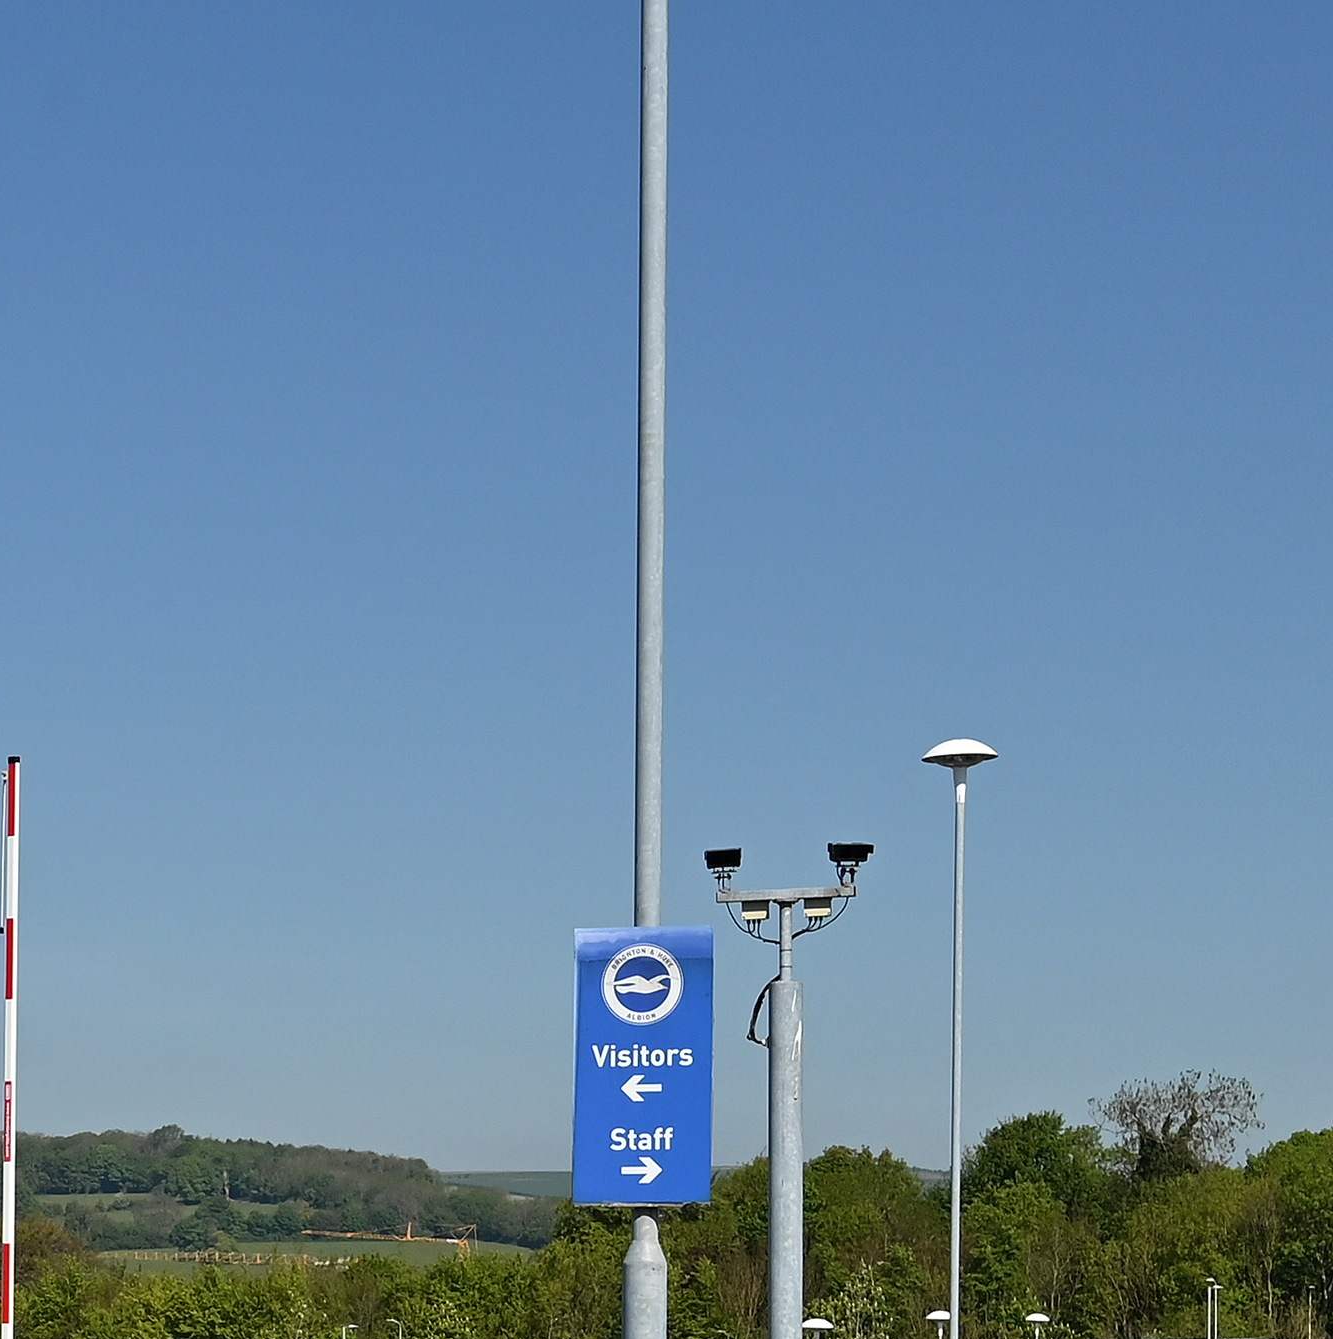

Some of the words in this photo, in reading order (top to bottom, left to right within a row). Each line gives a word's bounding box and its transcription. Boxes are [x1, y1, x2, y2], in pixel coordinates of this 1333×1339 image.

[627, 1013, 657, 1021] ALBION
[592, 1045, 694, 1068] Visitors
[609, 1127, 674, 1151] Staff
